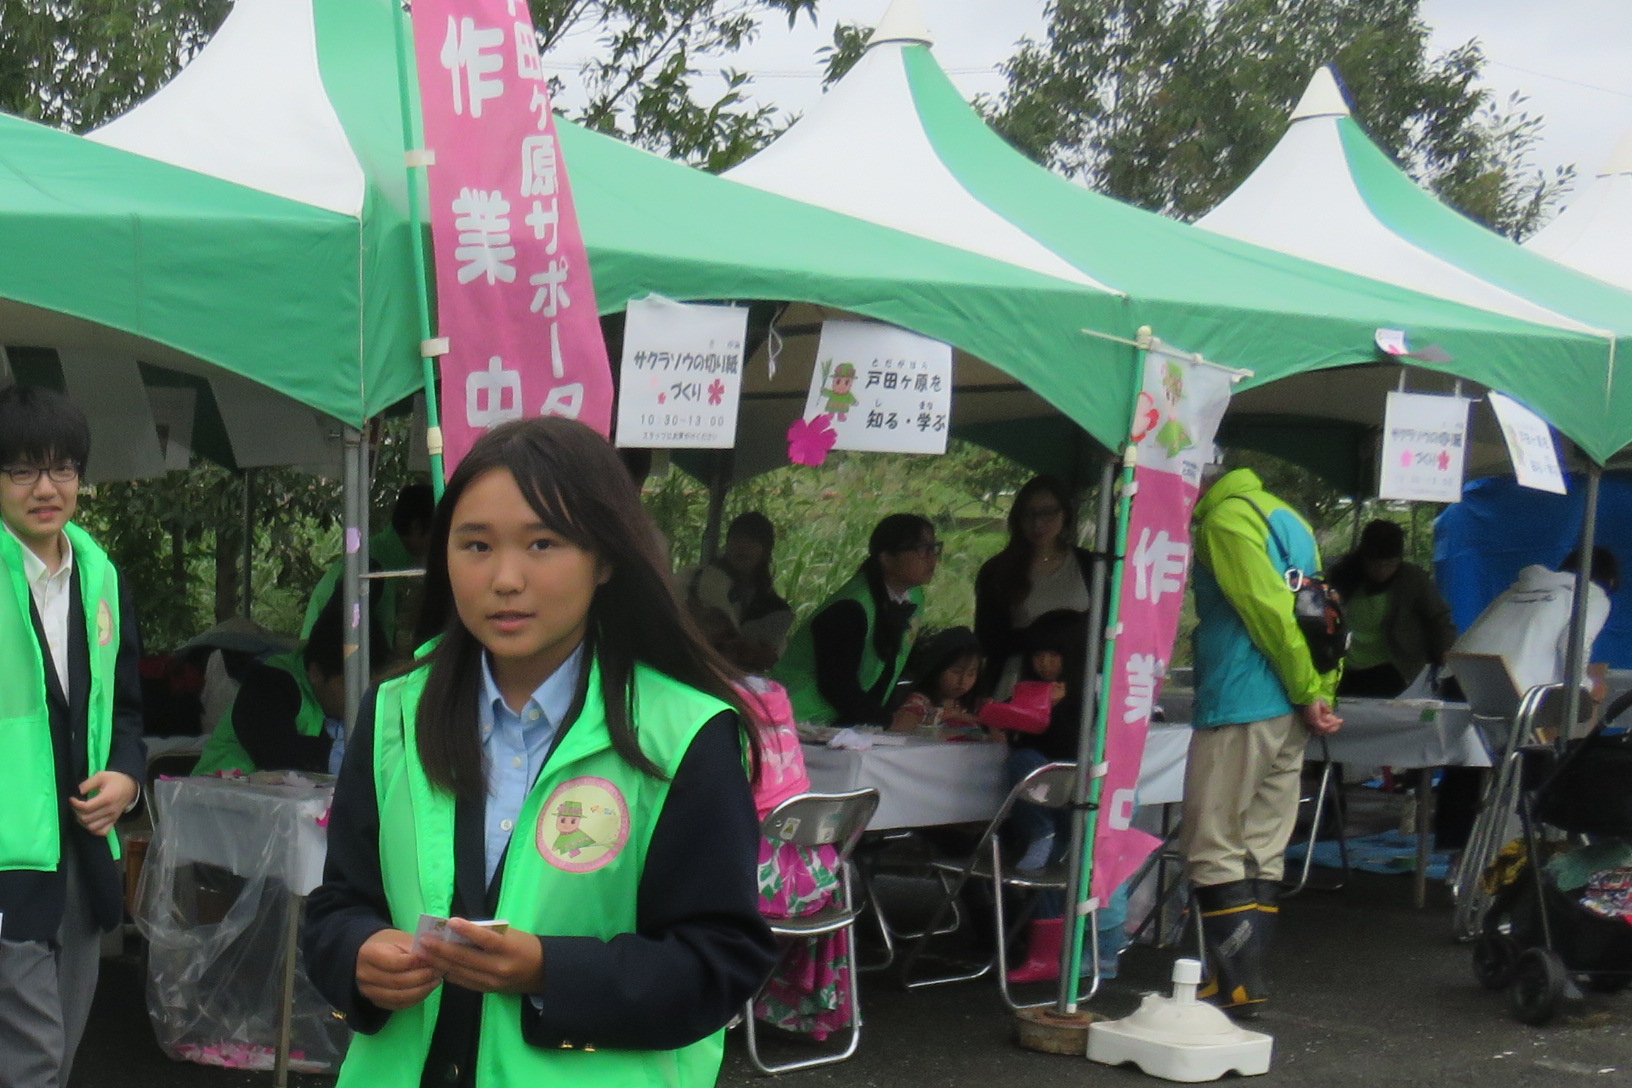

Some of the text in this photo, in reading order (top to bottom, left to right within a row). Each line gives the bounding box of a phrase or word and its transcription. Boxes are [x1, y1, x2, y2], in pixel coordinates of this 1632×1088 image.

[441, 14, 523, 428] 作業中
[634, 350, 738, 375] サクラソウの切り紙
[670, 381, 702, 402] づくり
